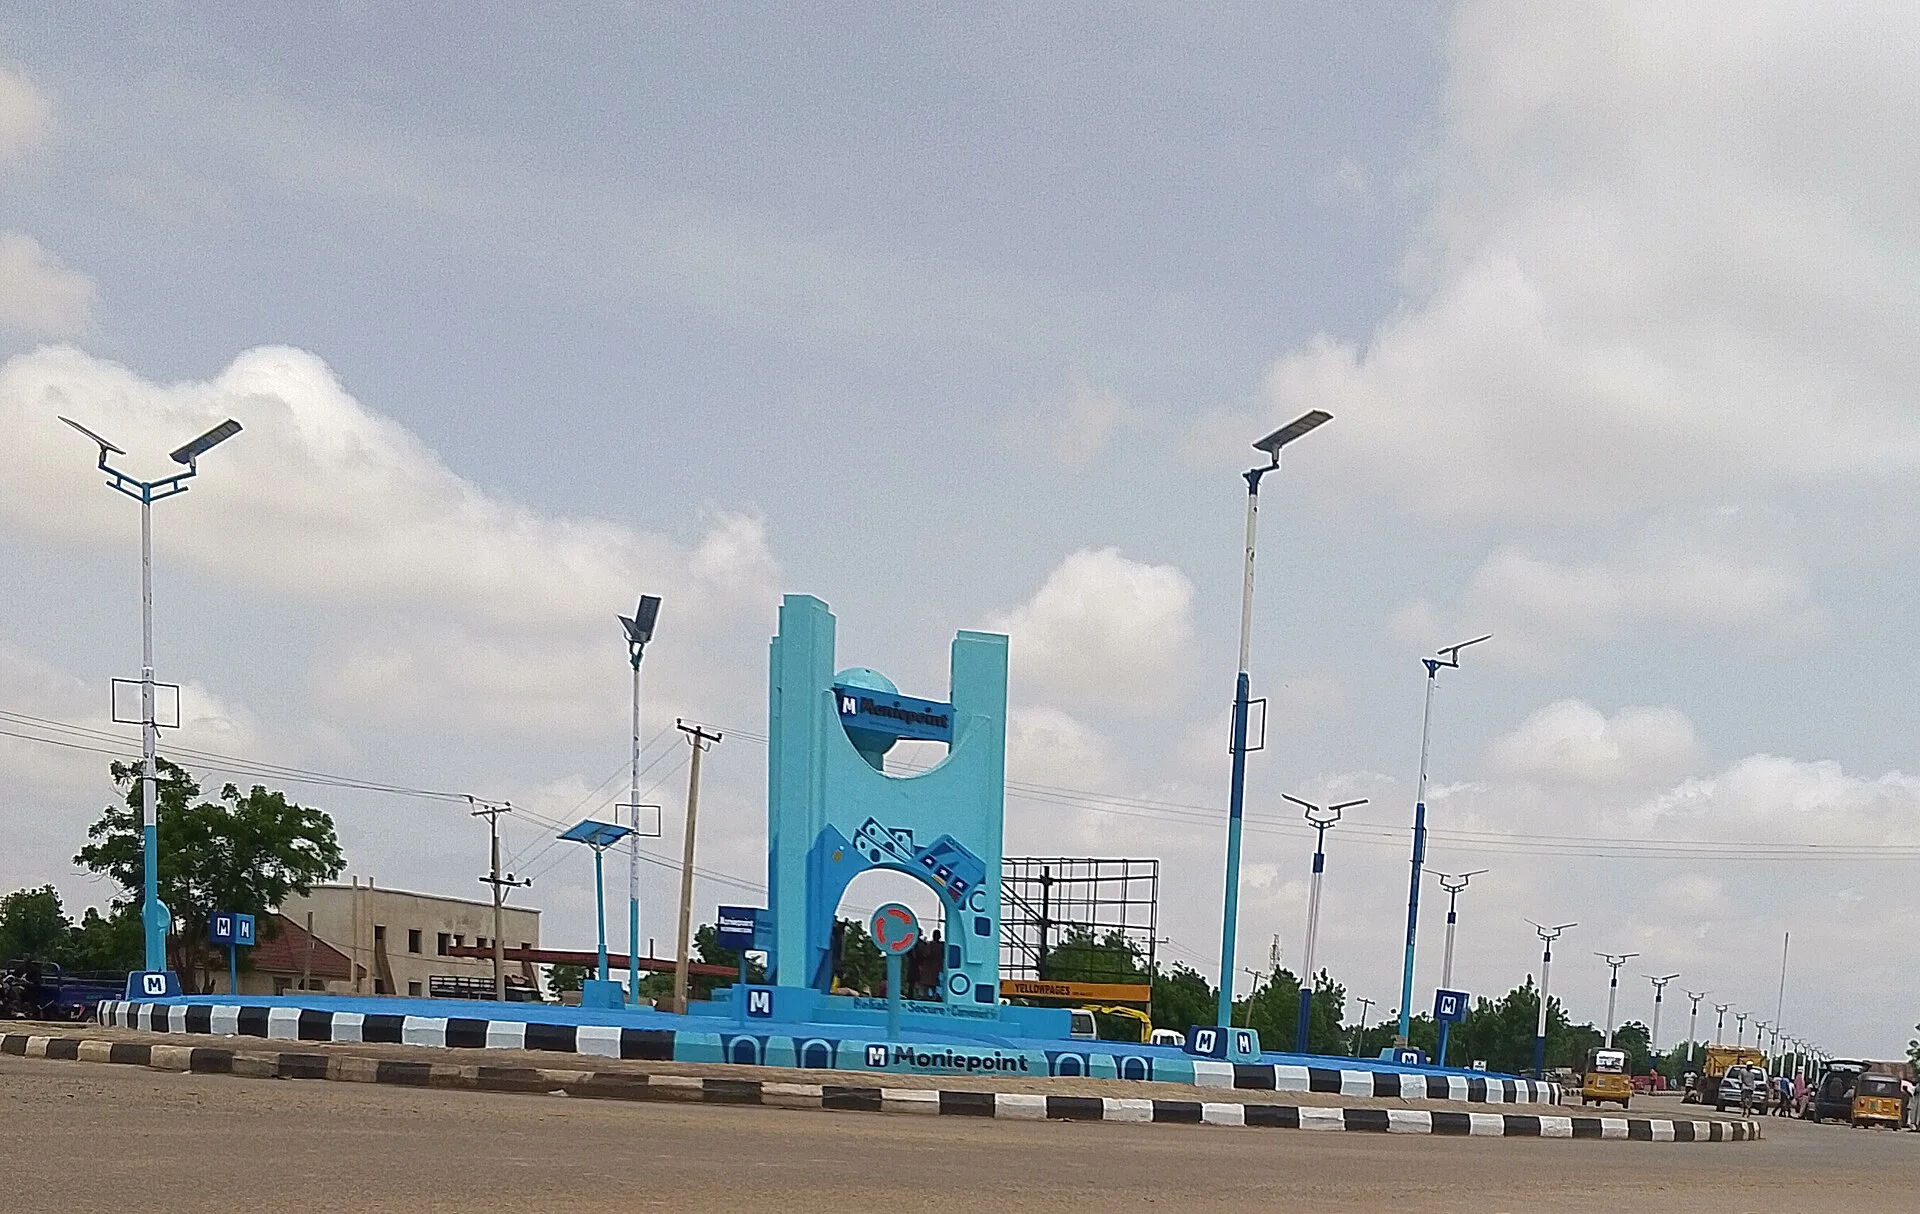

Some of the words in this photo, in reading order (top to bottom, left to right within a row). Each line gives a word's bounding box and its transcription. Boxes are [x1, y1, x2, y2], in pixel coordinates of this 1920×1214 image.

[842, 696, 857, 715] M
[1014, 983, 1071, 996] YELLOWPAGES
[750, 991, 769, 1013] M
[1239, 1035, 1250, 1052] M
[868, 1047, 886, 1066] M
[893, 1045, 1029, 1072] Moniepoint
